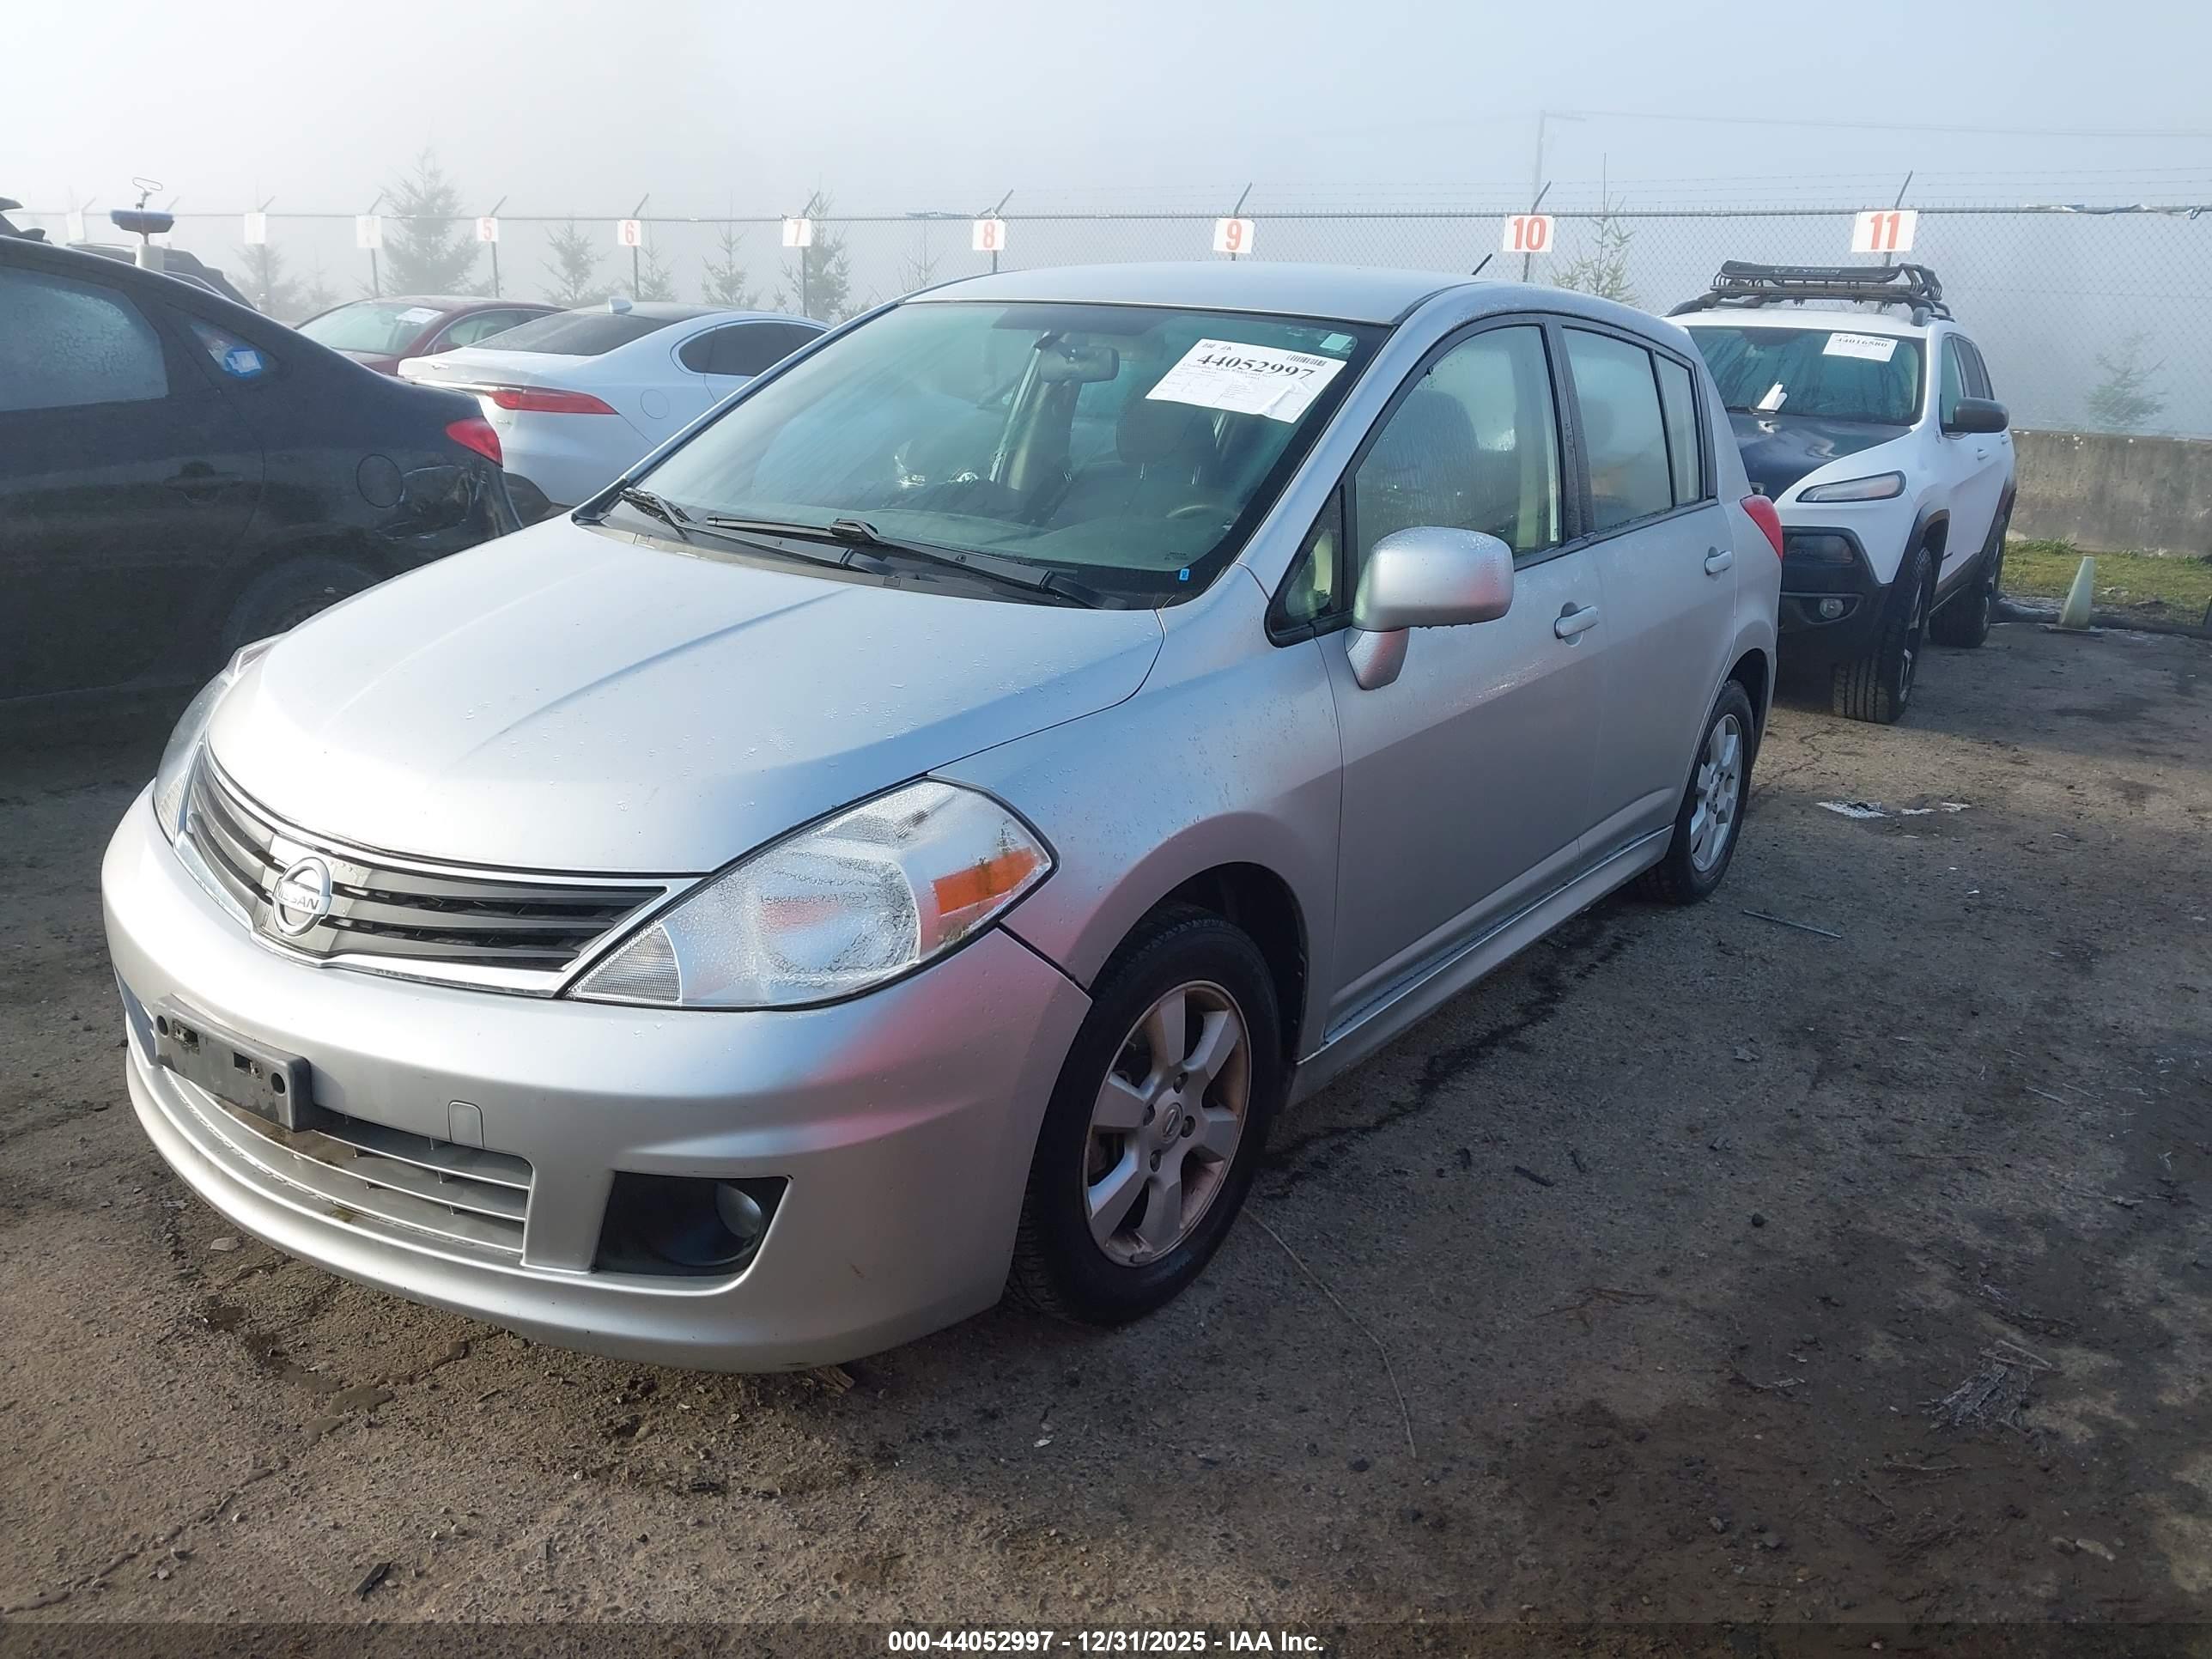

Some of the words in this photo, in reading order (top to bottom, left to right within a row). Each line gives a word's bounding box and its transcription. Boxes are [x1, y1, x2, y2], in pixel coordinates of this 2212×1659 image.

[483, 219, 493, 241] 5
[624, 222, 635, 245] 6
[792, 221, 805, 246] 7
[982, 222, 995, 249] 8
[1225, 219, 1243, 252] 9
[1514, 215, 1547, 252] 10
[1869, 212, 1901, 251] 11
[1197, 353, 1316, 380] 44052997
